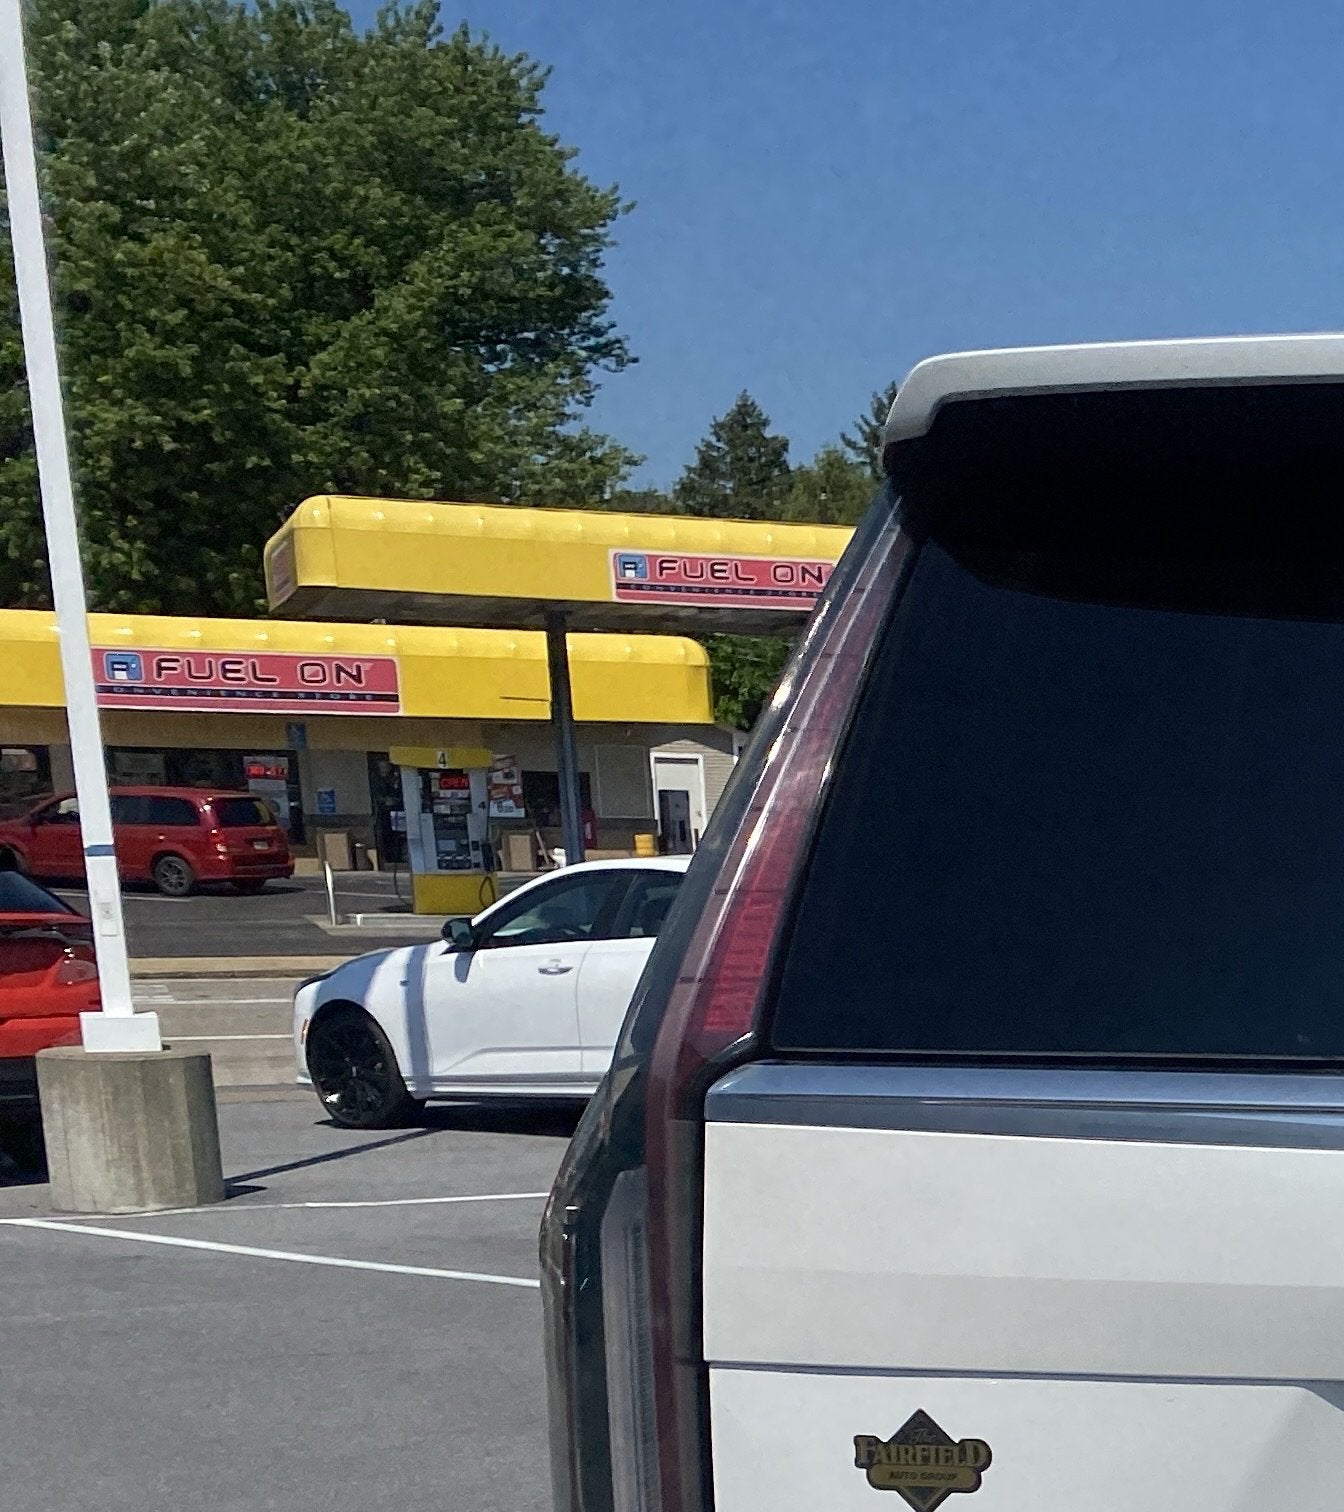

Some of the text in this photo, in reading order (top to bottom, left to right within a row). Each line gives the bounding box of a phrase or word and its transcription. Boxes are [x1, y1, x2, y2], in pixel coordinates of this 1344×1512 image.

[657, 559, 824, 584] FUEL ON
[154, 656, 365, 685] FUEL ON
[438, 752, 447, 768] 4
[858, 1437, 985, 1467] FAIRFIELD
[889, 1471, 958, 1482] AUTO GROUP
